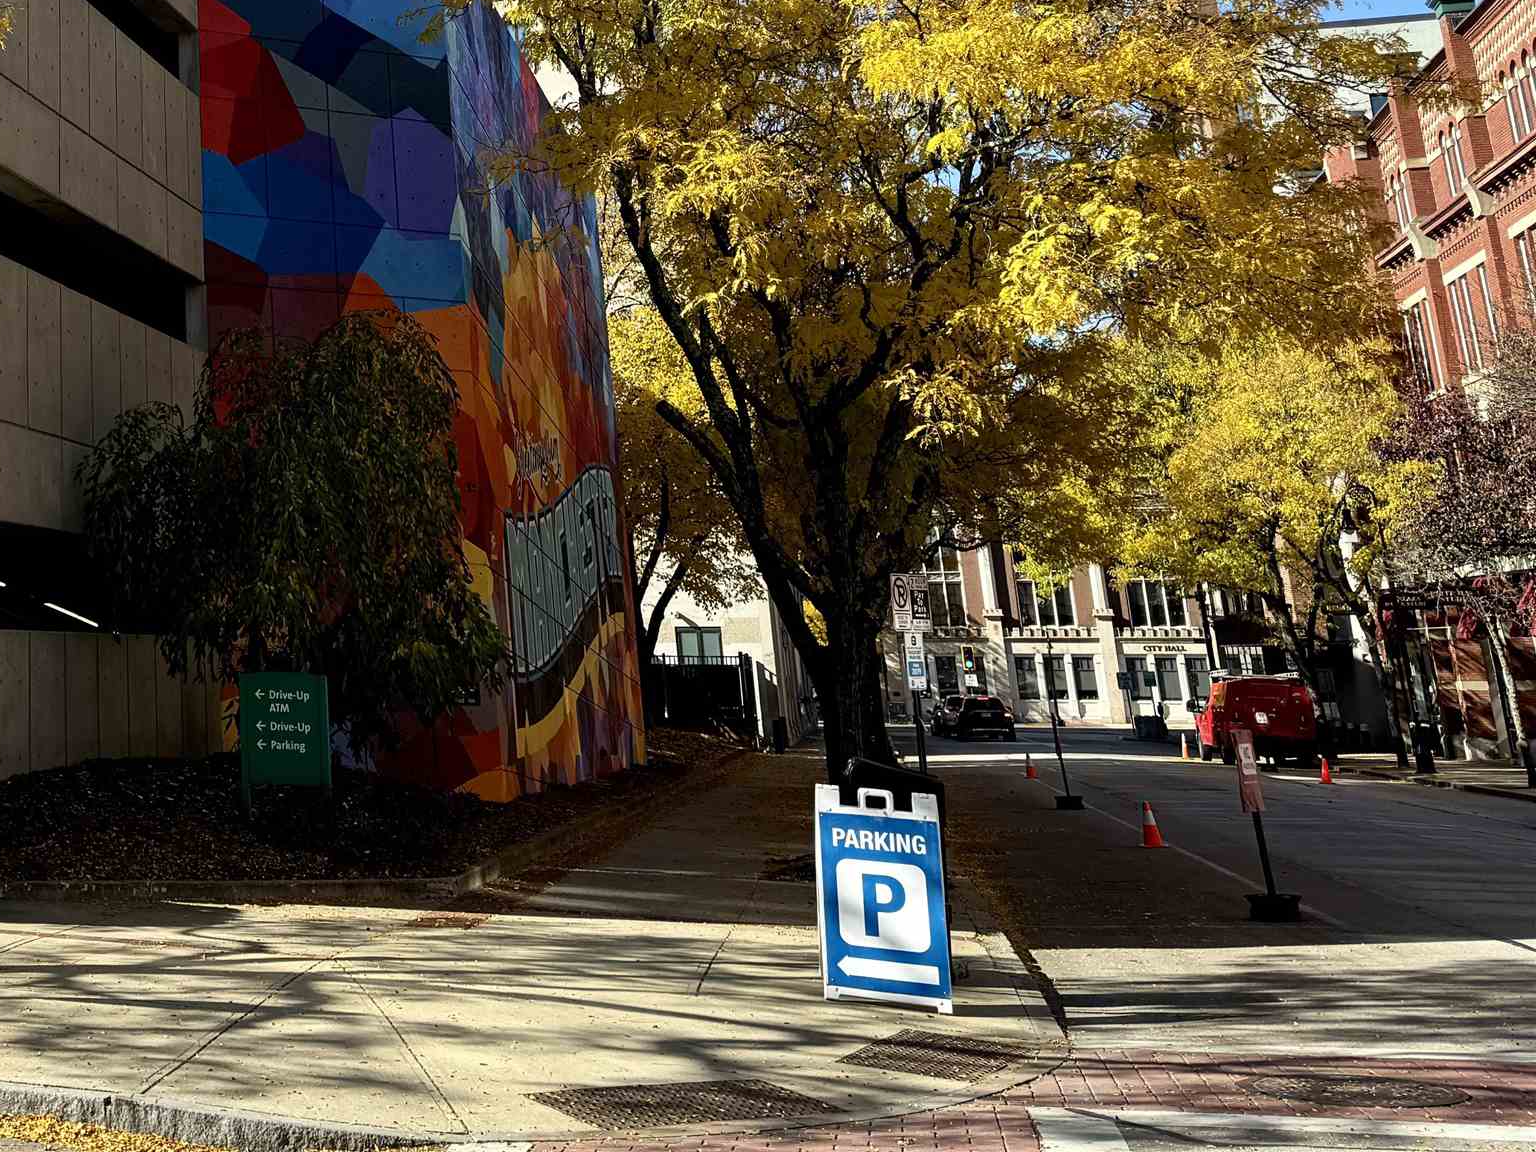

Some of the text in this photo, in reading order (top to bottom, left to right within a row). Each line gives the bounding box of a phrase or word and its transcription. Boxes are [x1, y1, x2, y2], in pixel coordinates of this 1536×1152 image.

[269, 690, 310, 703] Drive-Up
[269, 704, 290, 713] ATM
[270, 722, 311, 735] Drive-Up
[271, 740, 306, 753] Parking
[832, 827, 927, 855] PARKING
[862, 873, 906, 937] P
